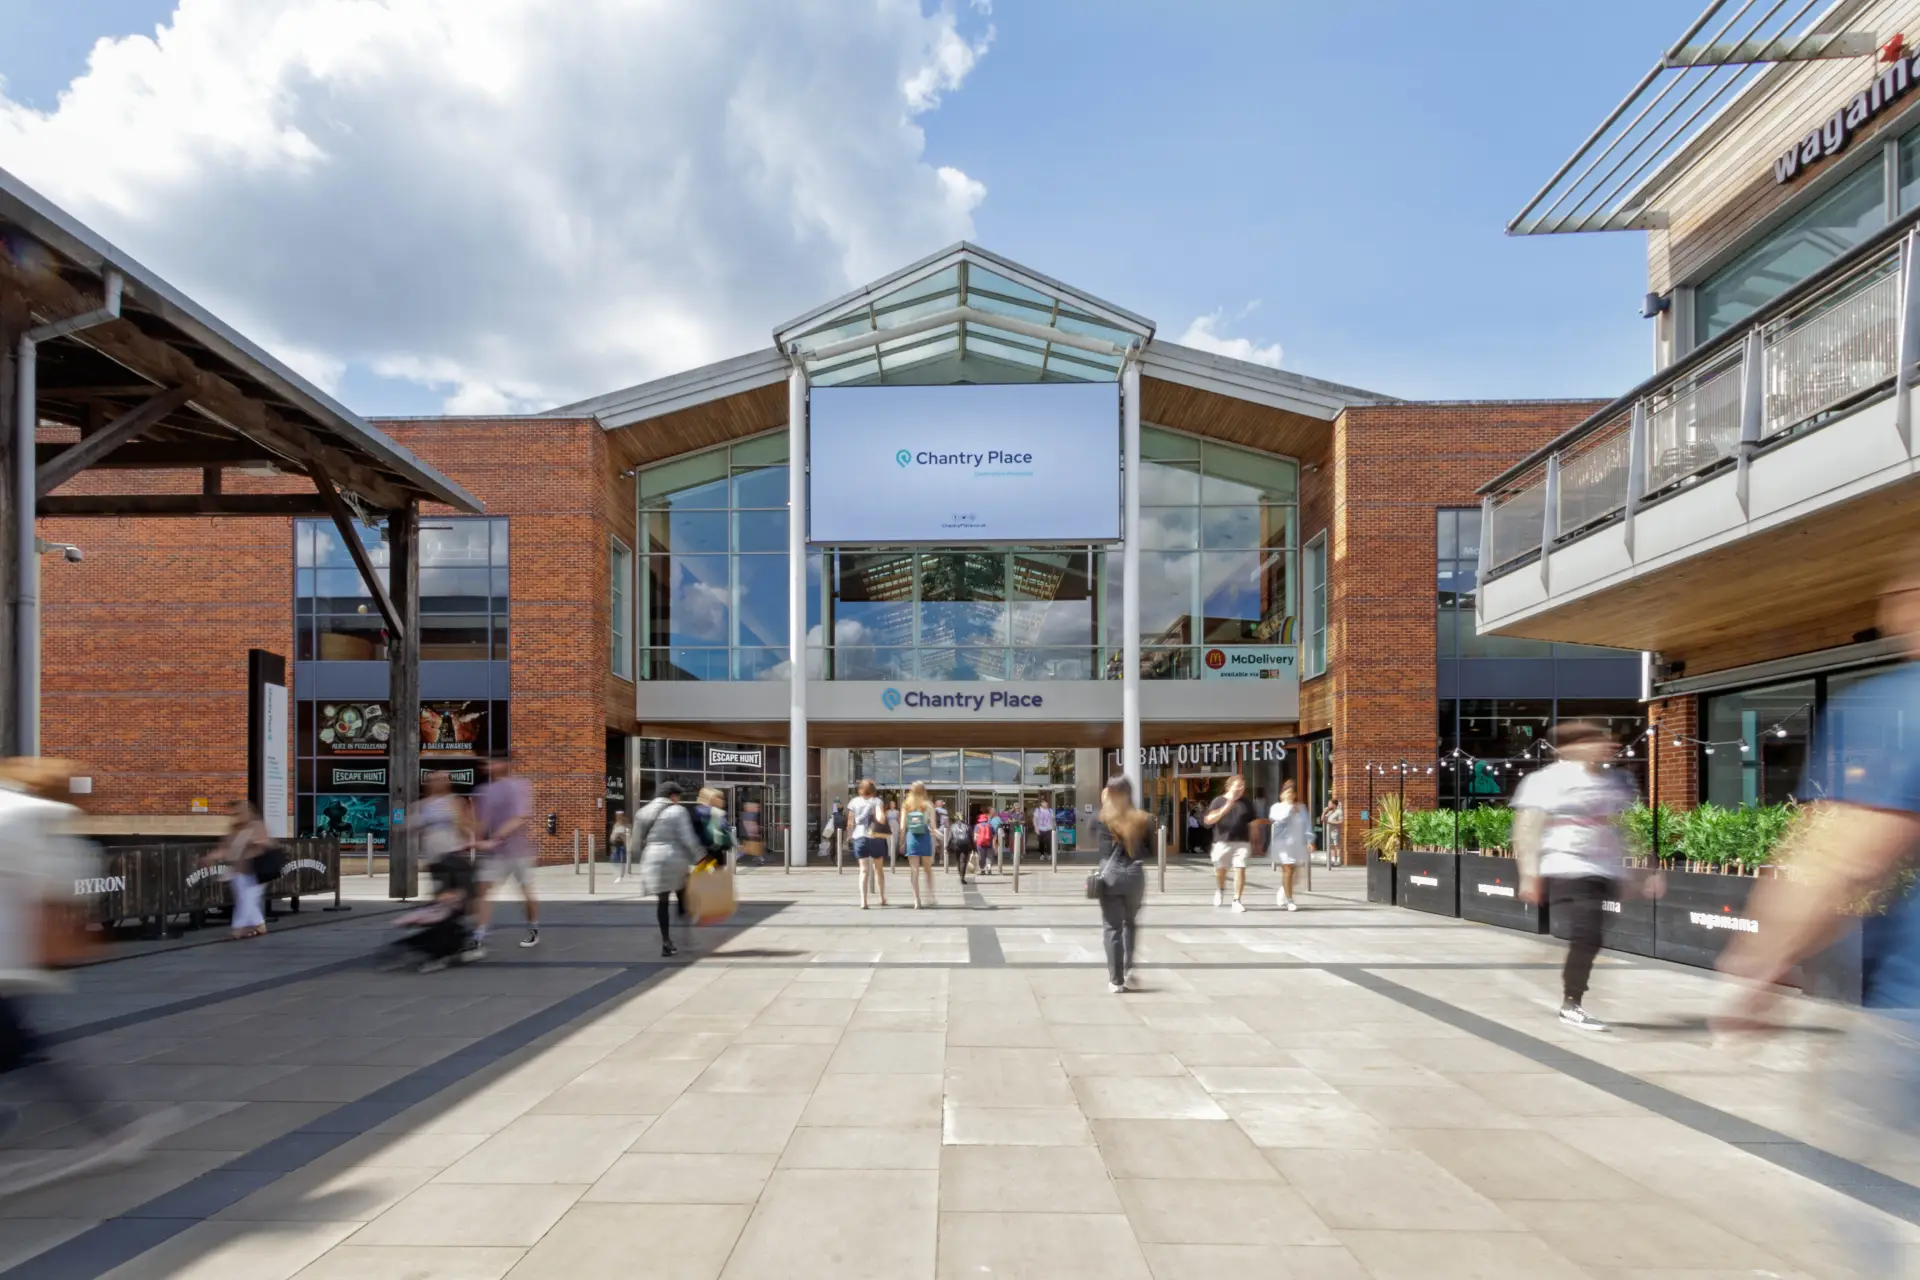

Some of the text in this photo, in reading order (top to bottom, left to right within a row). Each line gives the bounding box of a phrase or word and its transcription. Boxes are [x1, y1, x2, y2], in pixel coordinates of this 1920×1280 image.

[916, 450, 1032, 467] Chantry Place
[1231, 654, 1294, 665] McDelivery
[904, 690, 1043, 712] Chantry Place
[712, 752, 759, 764] ESCAPE HUNT
[1116, 740, 1287, 766] UBAN OUTFITTERS
[336, 772, 383, 781] ESCAPE HUNT
[451, 772, 471, 781] HUNT
[73, 875, 126, 895] BYRON
[185, 867, 209, 888] PROPER
[1689, 911, 1759, 933] wagamama
